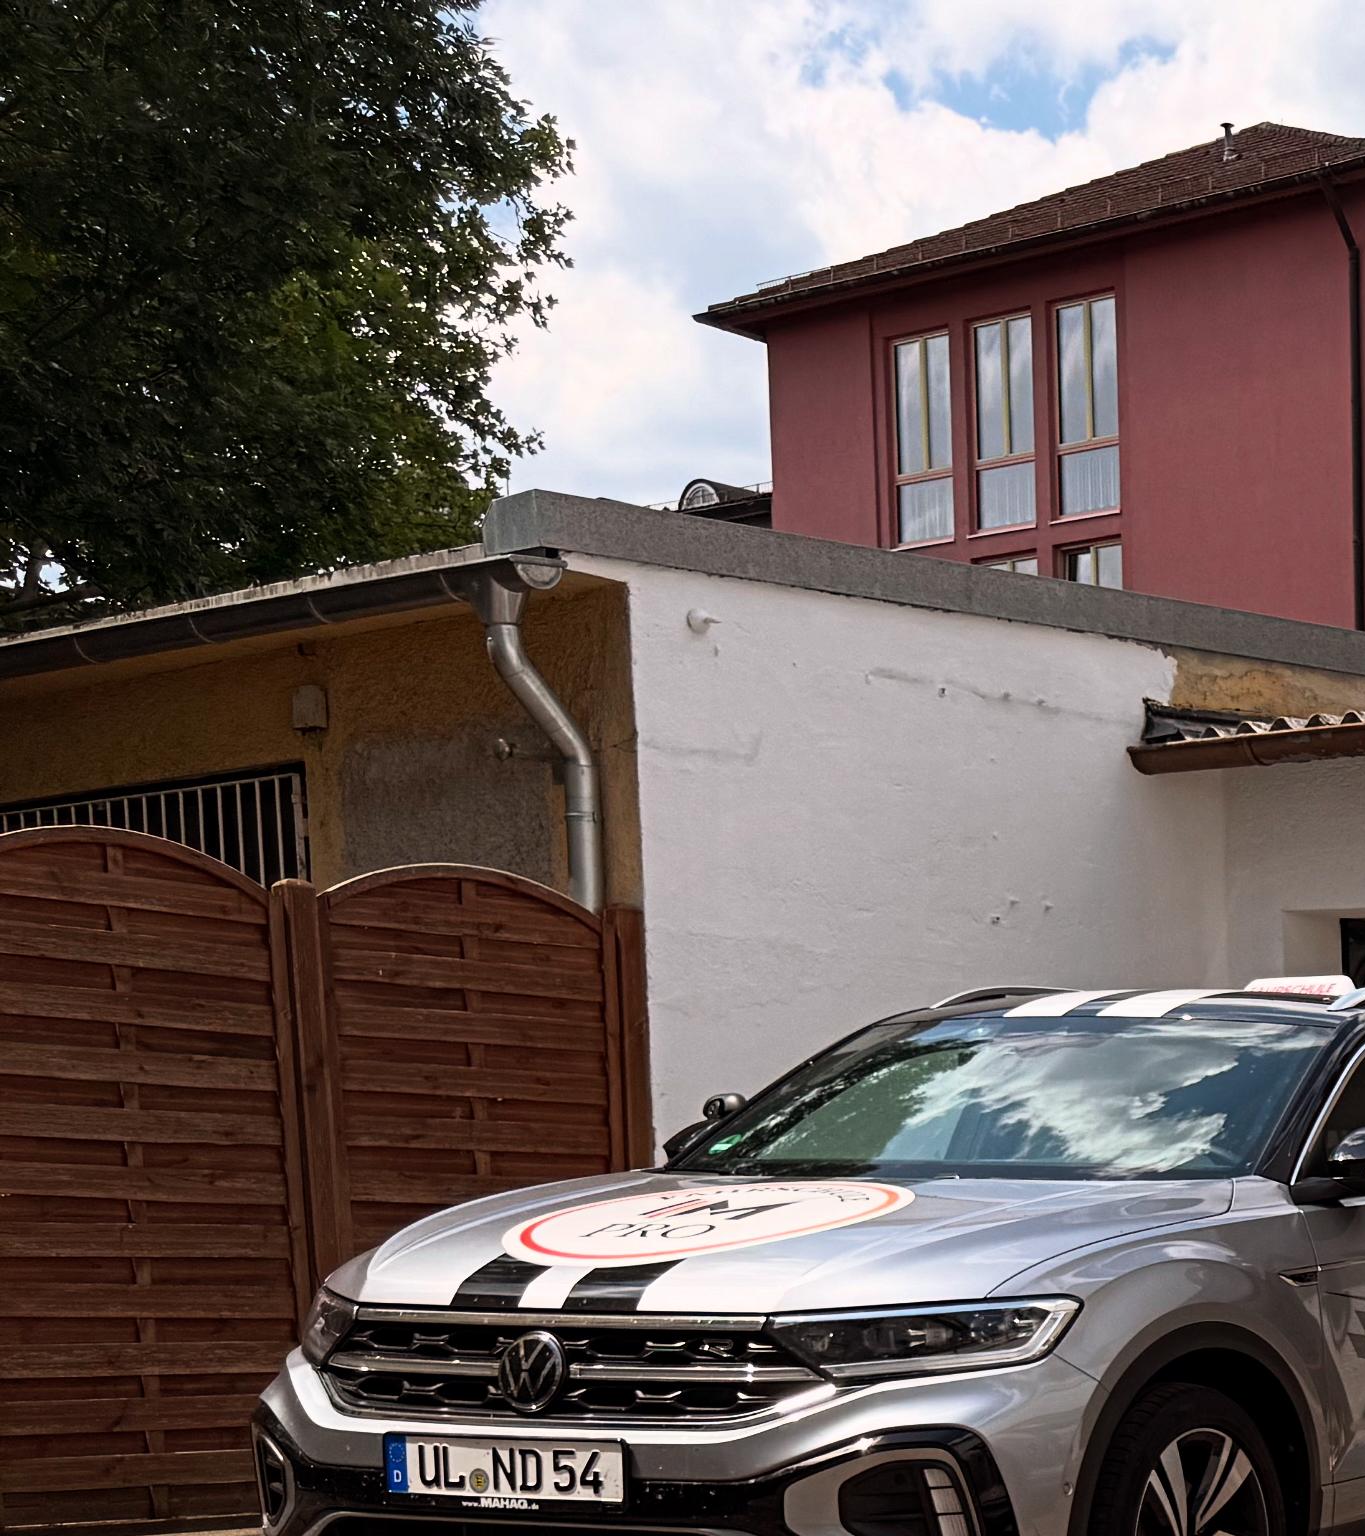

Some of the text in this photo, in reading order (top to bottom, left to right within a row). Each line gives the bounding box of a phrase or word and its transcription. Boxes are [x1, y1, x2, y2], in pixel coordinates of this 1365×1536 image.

[579, 1222, 716, 1239] PRO
[393, 1469, 402, 1483] D
[417, 1442, 605, 1497] UL ND 54
